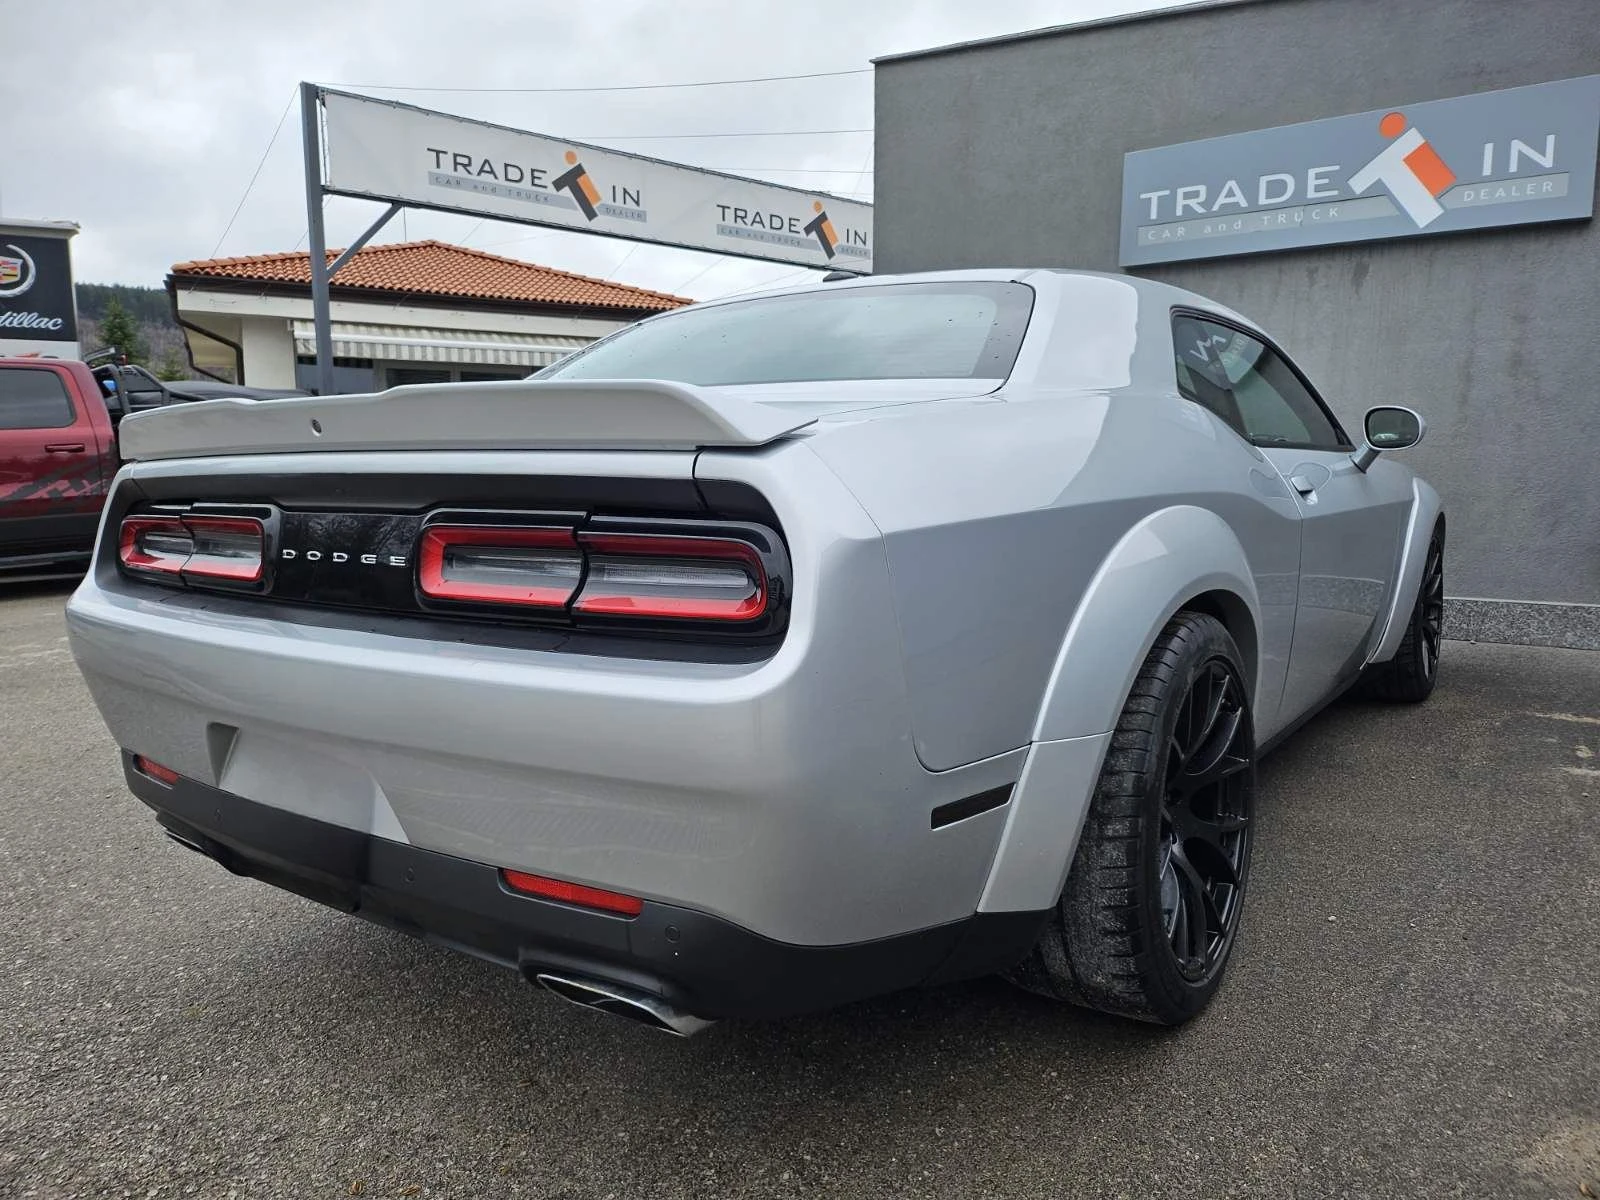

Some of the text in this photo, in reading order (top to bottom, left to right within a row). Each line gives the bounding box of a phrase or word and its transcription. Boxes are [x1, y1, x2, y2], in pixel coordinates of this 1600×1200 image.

[427, 148, 548, 189] TRADE
[612, 185, 641, 207] IN
[435, 176, 643, 219] CAR and TRUCK DEALER
[1139, 165, 1341, 220] TRADE
[1481, 134, 1556, 176] IN
[716, 204, 800, 233] TRADE
[846, 228, 867, 246] IN
[1147, 180, 1554, 240] CAR and TRUCK DEALER
[282, 549, 407, 566] DODGE
